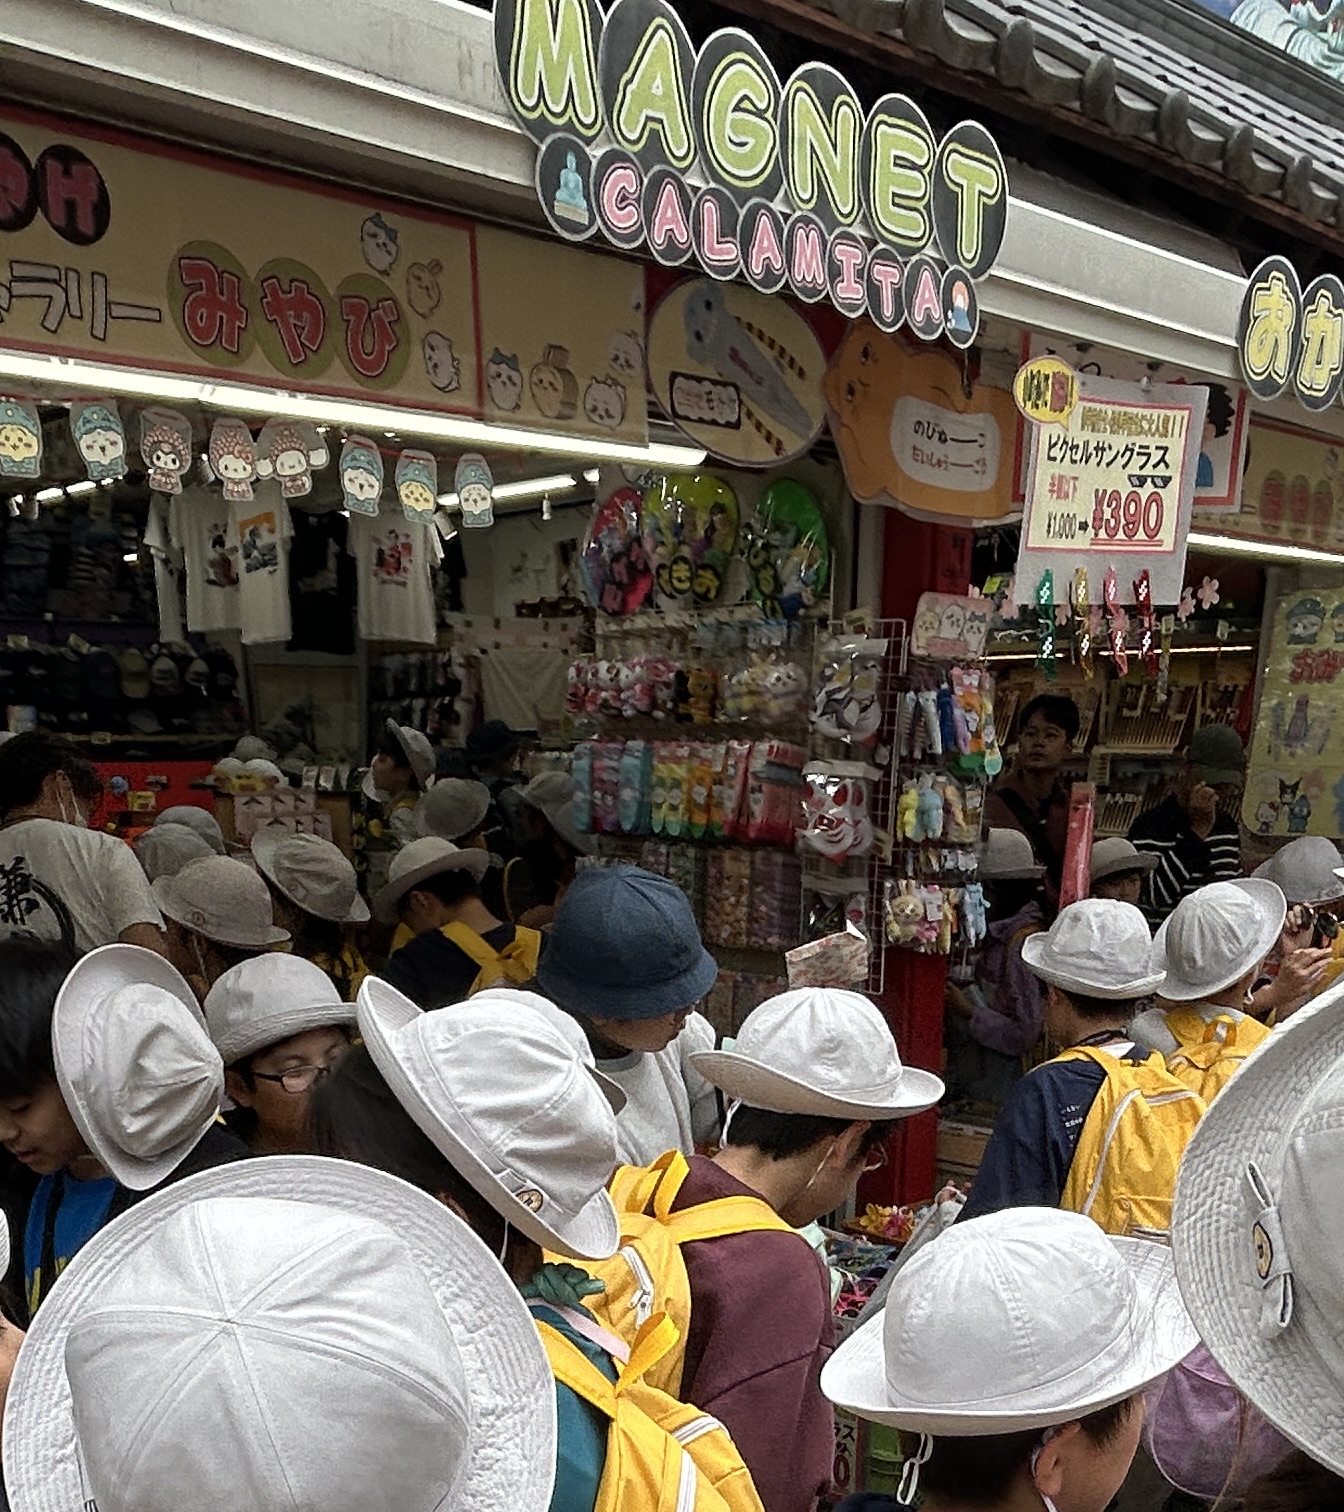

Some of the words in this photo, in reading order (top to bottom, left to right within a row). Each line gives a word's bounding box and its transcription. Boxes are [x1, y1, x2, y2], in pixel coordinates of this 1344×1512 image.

[511, 0, 1004, 267] MAGNET
[599, 162, 943, 328] CALAMITA
[179, 255, 400, 377] みやび
[1047, 434, 1170, 470] ピクセルサングラス
[1092, 488, 1164, 539] ¥390
